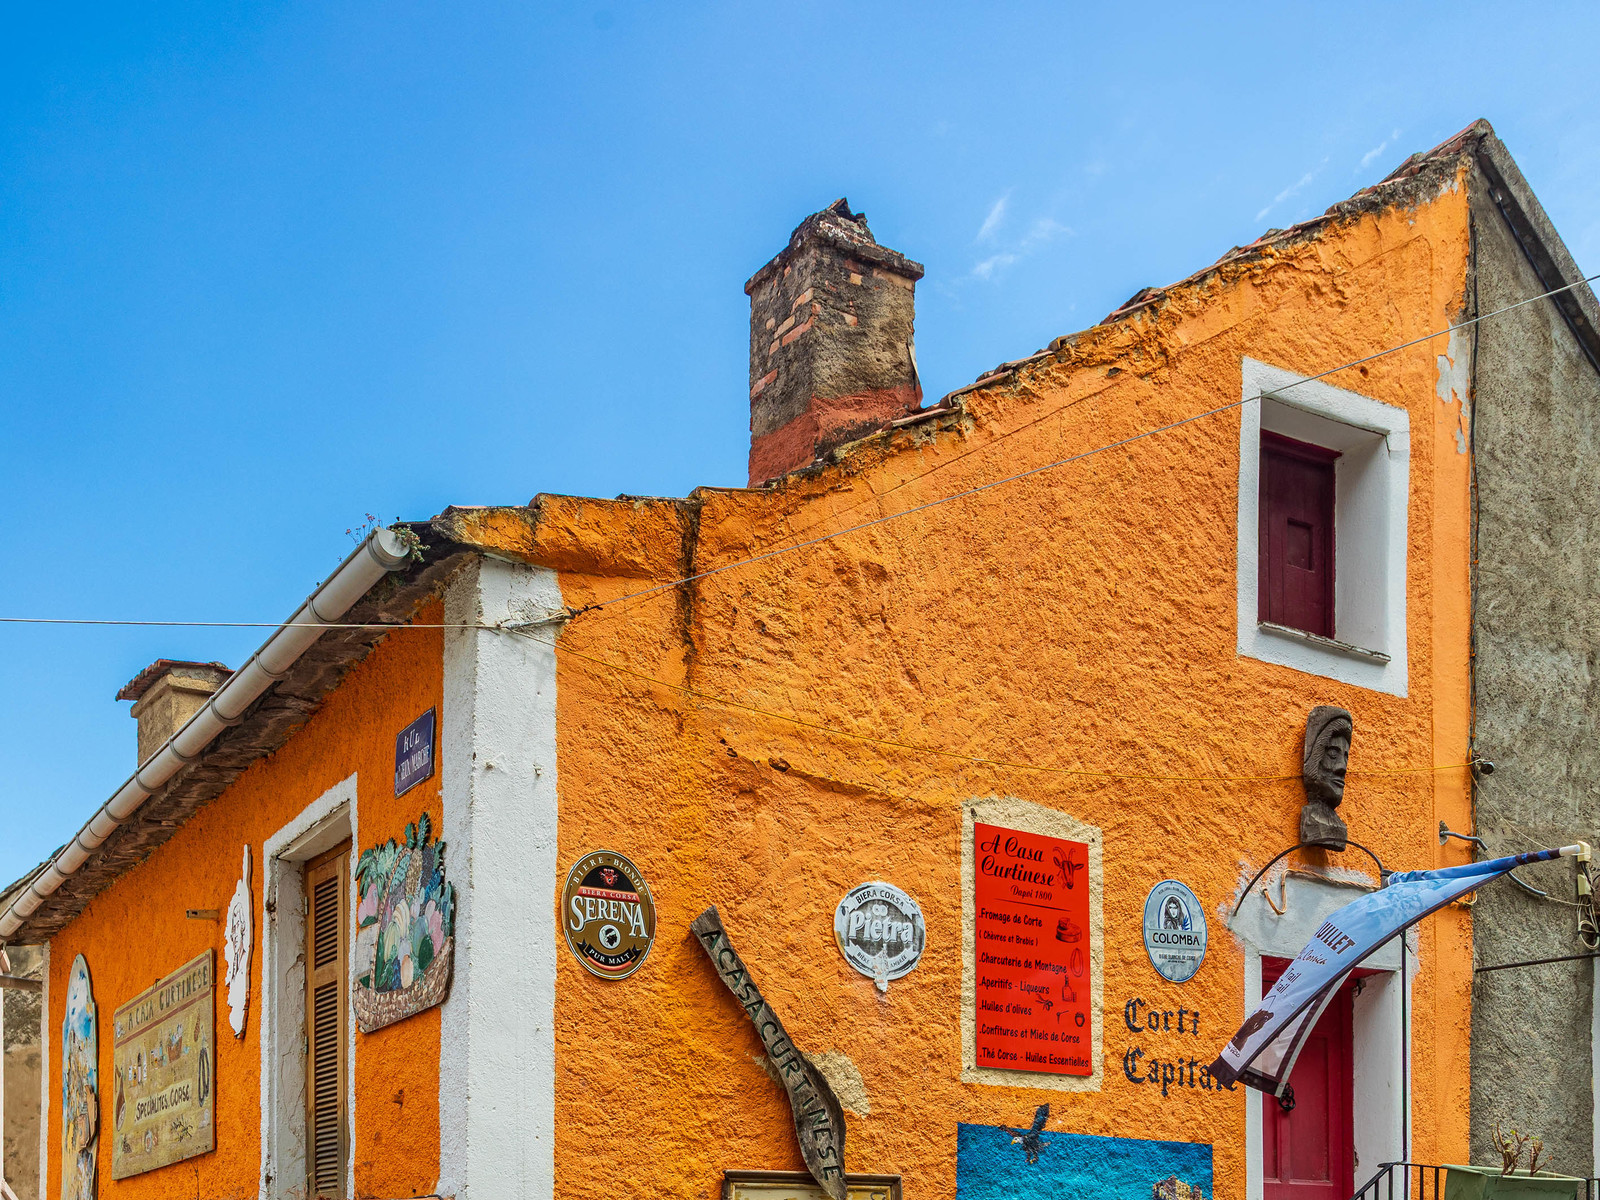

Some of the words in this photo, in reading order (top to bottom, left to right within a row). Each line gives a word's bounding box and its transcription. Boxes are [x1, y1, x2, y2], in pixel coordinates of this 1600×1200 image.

[981, 834, 1001, 854] A
[1005, 836, 1044, 862] Casa
[613, 859, 645, 892] BLONDE
[981, 855, 1055, 886] Curtinese
[582, 889, 606, 897] BIERA
[855, 889, 877, 904] BIERA
[1035, 890, 1053, 900] 1800
[570, 895, 649, 938] SERENA
[1013, 914, 1021, 924] de
[1023, 915, 1043, 927] Corte
[849, 911, 914, 943] Pietra
[1008, 935, 1014, 943] et
[1153, 932, 1200, 946] COLOMBA
[588, 949, 605, 963] PUR
[608, 953, 630, 964] MALT
[1024, 959, 1032, 969] de
[1034, 960, 1067, 975] Montagne
[159, 965, 208, 1011] CURTINESE
[718, 948, 764, 1021] CASA
[1020, 981, 1050, 995] Liqueurs
[1005, 1002, 1032, 1015] d'olives
[1124, 997, 1200, 1036] Corti
[1020, 1030, 1027, 1038] et
[1030, 1029, 1048, 1040] Miels
[1050, 1032, 1059, 1041] de
[1061, 1032, 1080, 1043] Corse
[997, 1049, 1018, 1060] Corse
[1025, 1051, 1047, 1063] Huiles
[1049, 1053, 1089, 1067] Essentielles
